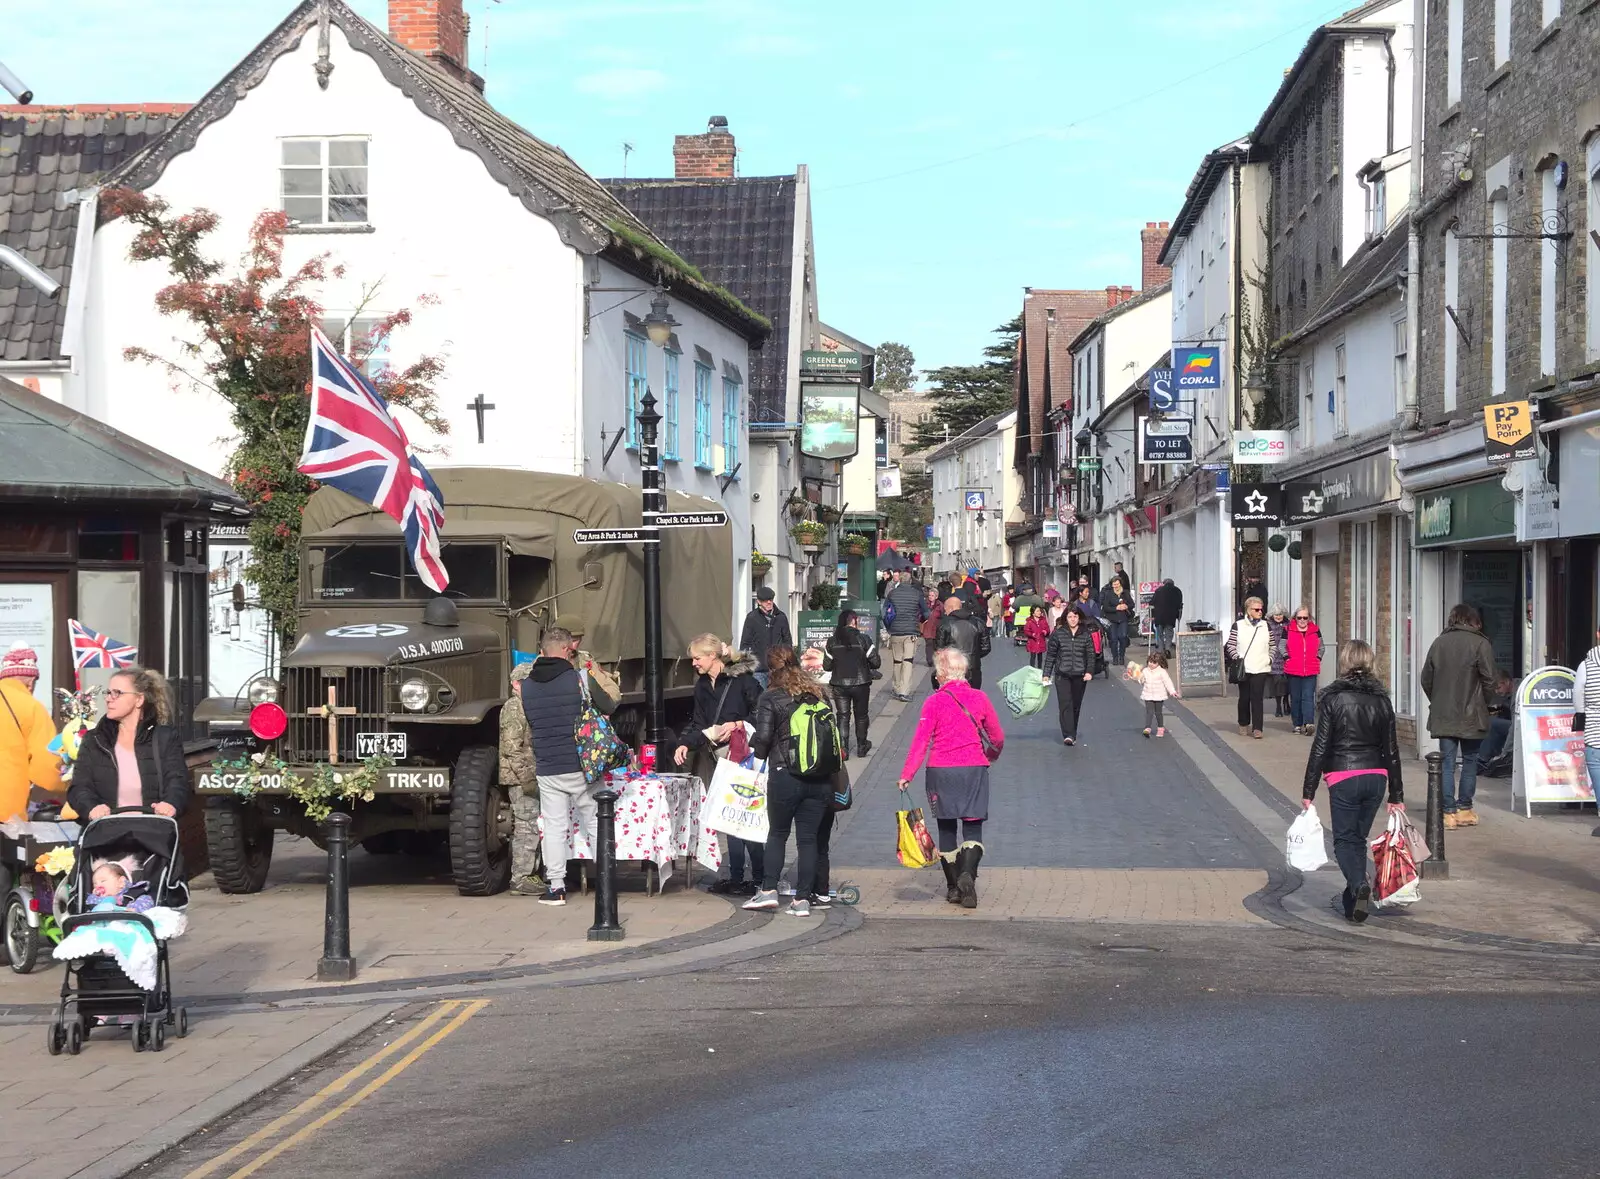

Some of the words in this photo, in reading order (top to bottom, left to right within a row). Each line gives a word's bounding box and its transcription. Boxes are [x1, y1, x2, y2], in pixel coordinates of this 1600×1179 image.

[1153, 371, 1172, 379] WH
[1180, 376, 1215, 385] CORAL
[1153, 379, 1173, 409] S
[1496, 423, 1512, 431] Pay
[1497, 429, 1522, 438] Point
[1155, 440, 1166, 448] TO
[1168, 440, 1181, 448] LET
[656, 516, 672, 525] Chapel
[1234, 513, 1278, 521] Superdrug
[577, 532, 588, 541] Play
[398, 643, 430, 659] U.S.A.
[431, 637, 464, 654] 4100761
[721, 805, 762, 826] COUNTS
